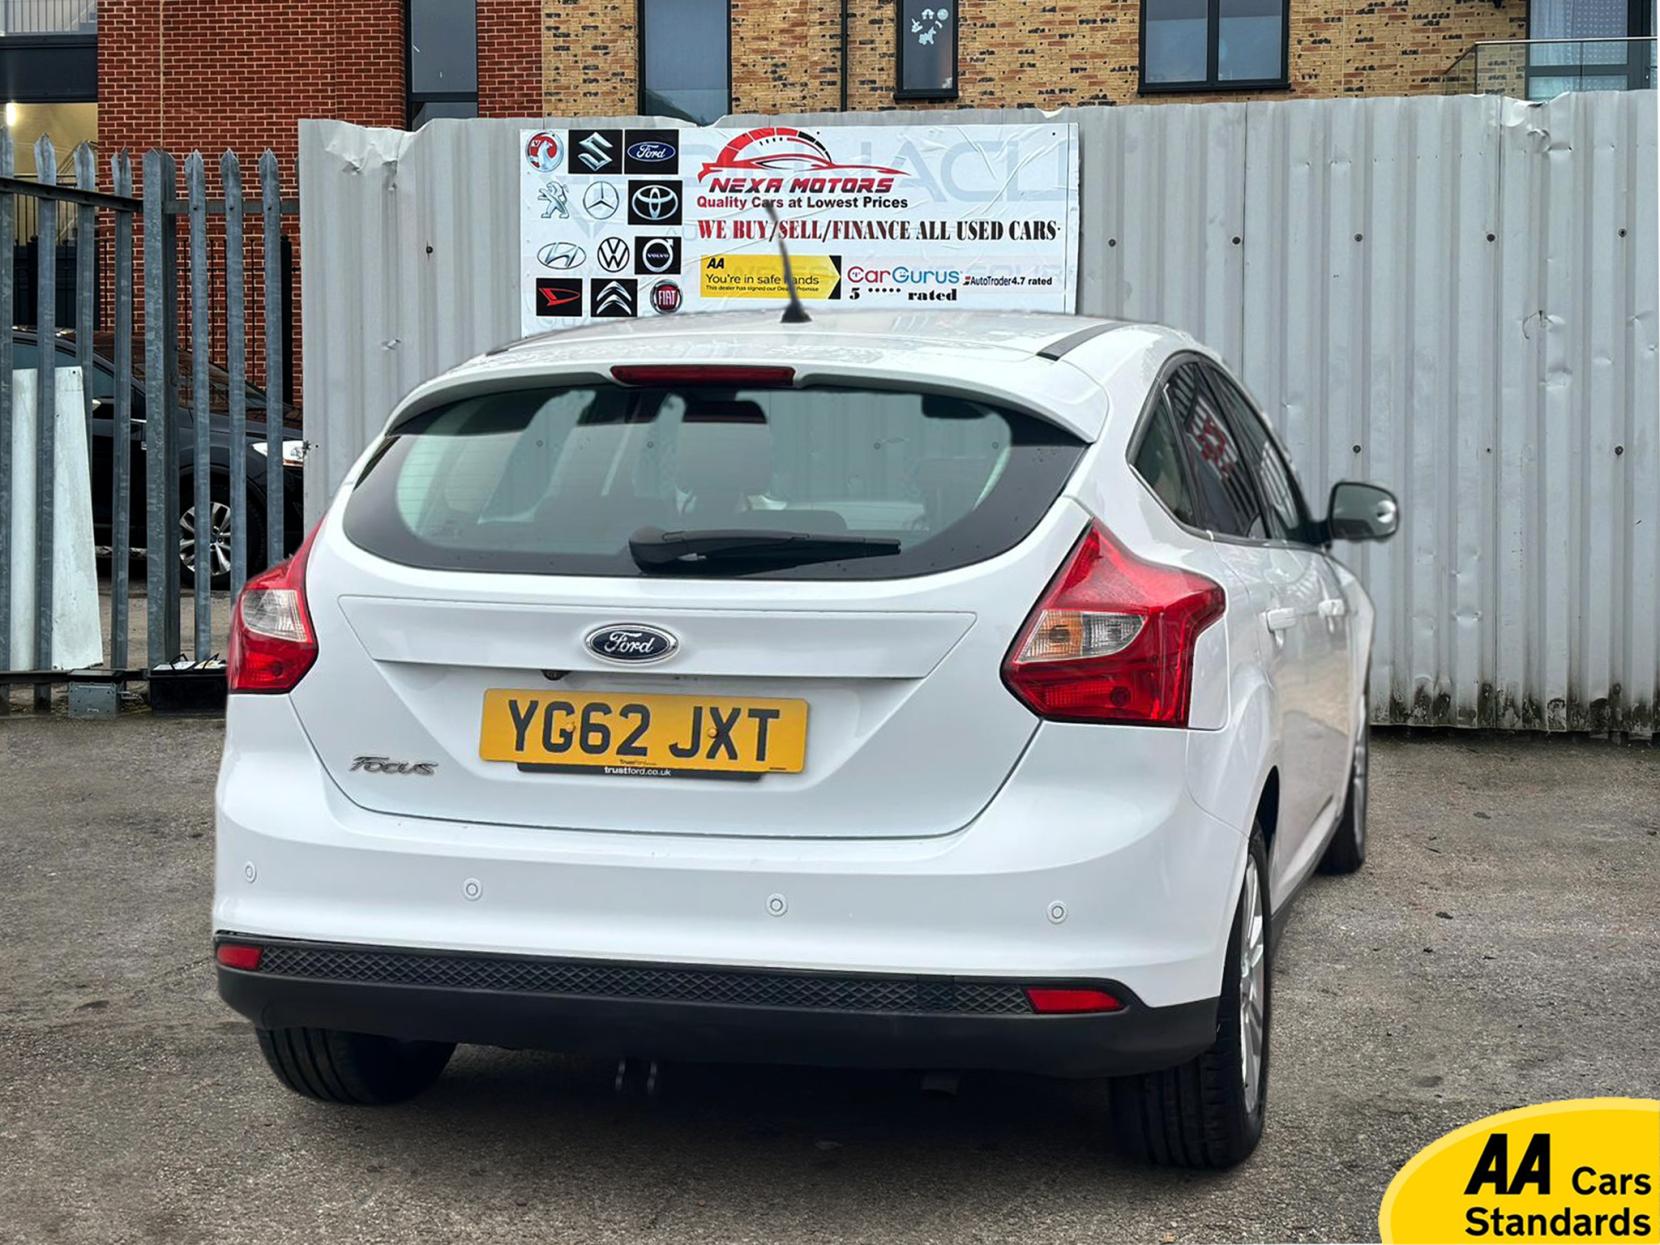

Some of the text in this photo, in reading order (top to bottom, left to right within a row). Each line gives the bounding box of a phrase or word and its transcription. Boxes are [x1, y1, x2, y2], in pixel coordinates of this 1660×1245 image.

[636, 143, 667, 160] Ford
[709, 178, 894, 193] NEXA MOTORS
[697, 196, 908, 210] Quality Cars at Lowest Prices
[697, 220, 727, 239] WE
[916, 220, 950, 240] ALL
[956, 220, 1004, 240] USED
[1008, 220, 1057, 240] CARS
[706, 257, 725, 269] AA
[706, 274, 819, 285] You're in safe ands
[847, 266, 960, 284] CarGurus
[1028, 277, 1053, 285] rated
[658, 290, 676, 305] FIAT
[849, 287, 957, 301] 5 rated
[604, 631, 656, 653] Ford
[508, 699, 781, 762] YG62 JXT
[604, 766, 671, 777] trustford.co.uk
